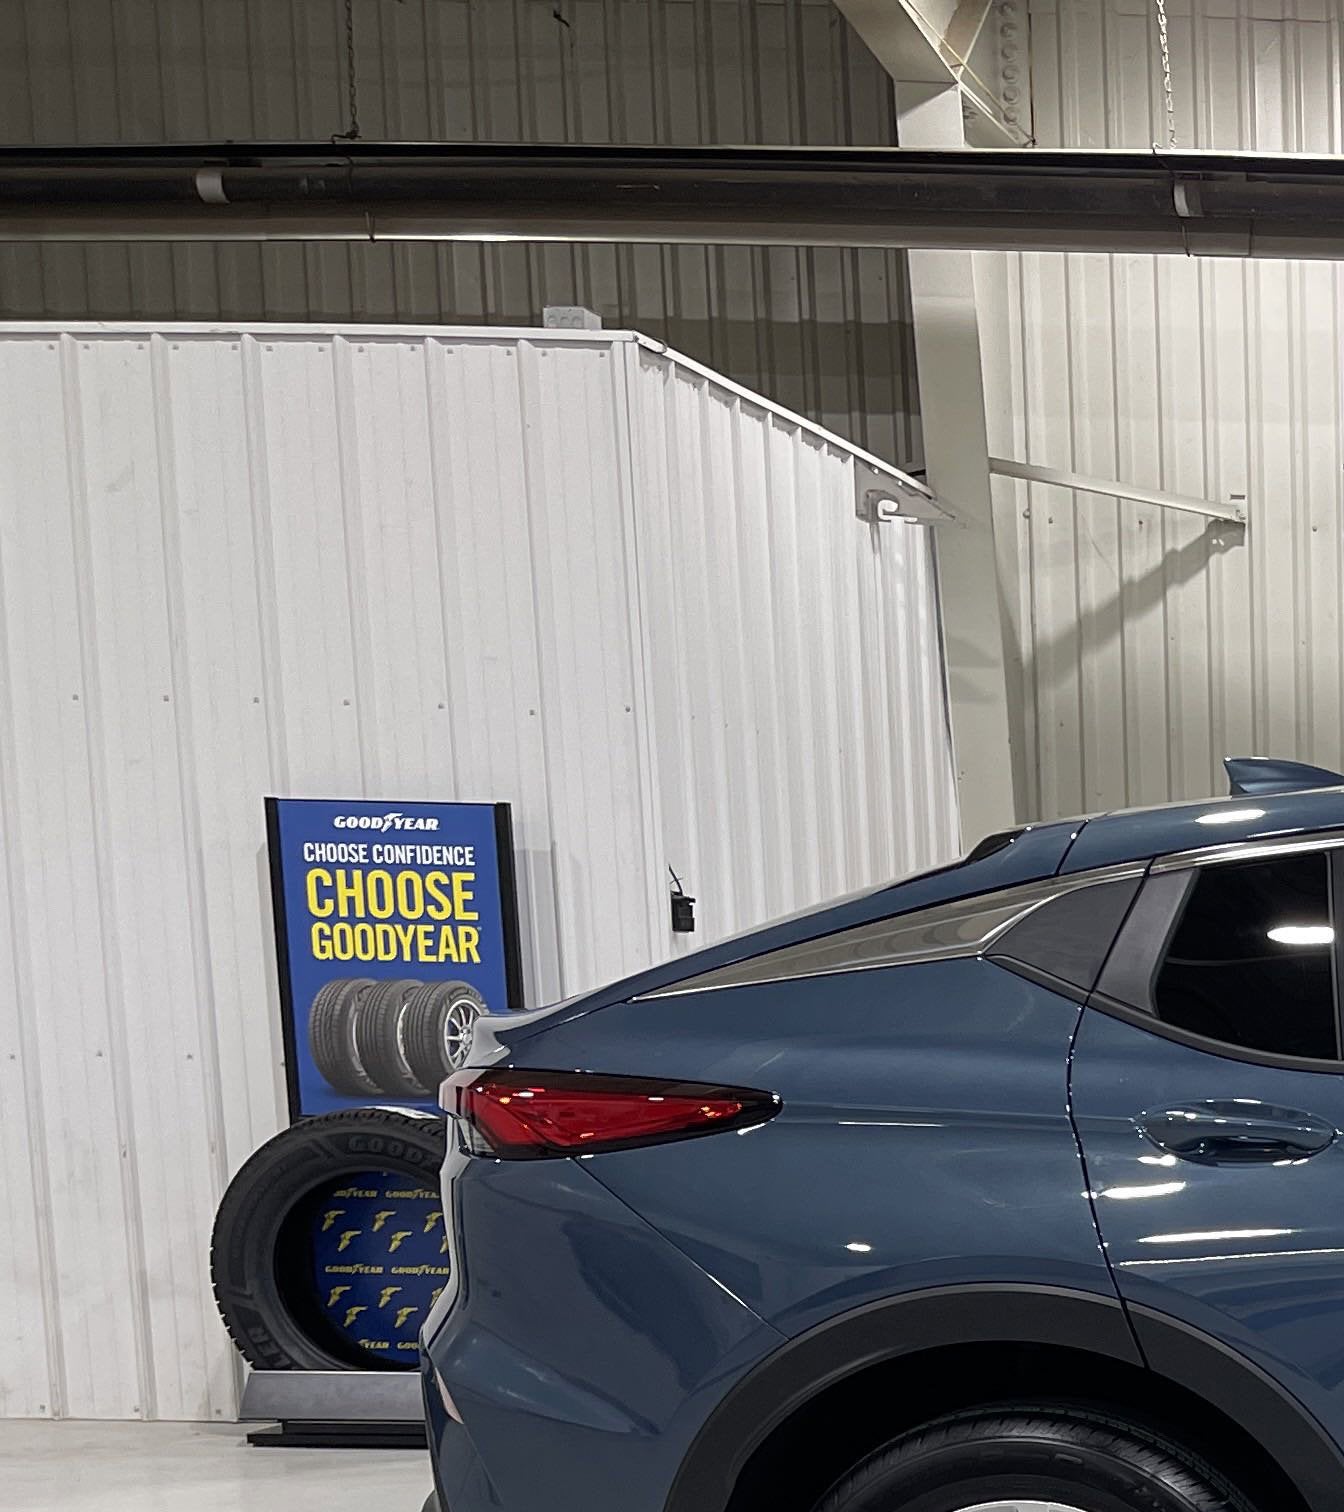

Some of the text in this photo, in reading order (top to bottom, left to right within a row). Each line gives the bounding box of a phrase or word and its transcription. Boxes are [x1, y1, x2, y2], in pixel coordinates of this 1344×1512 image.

[333, 813, 439, 833] GOODYEAR
[303, 842, 476, 866] CHOOSE CONFIDENCE
[306, 868, 479, 921] CHOOSE
[311, 922, 481, 964] GOODYEAR
[325, 1264, 384, 1275] GOODYEAR
